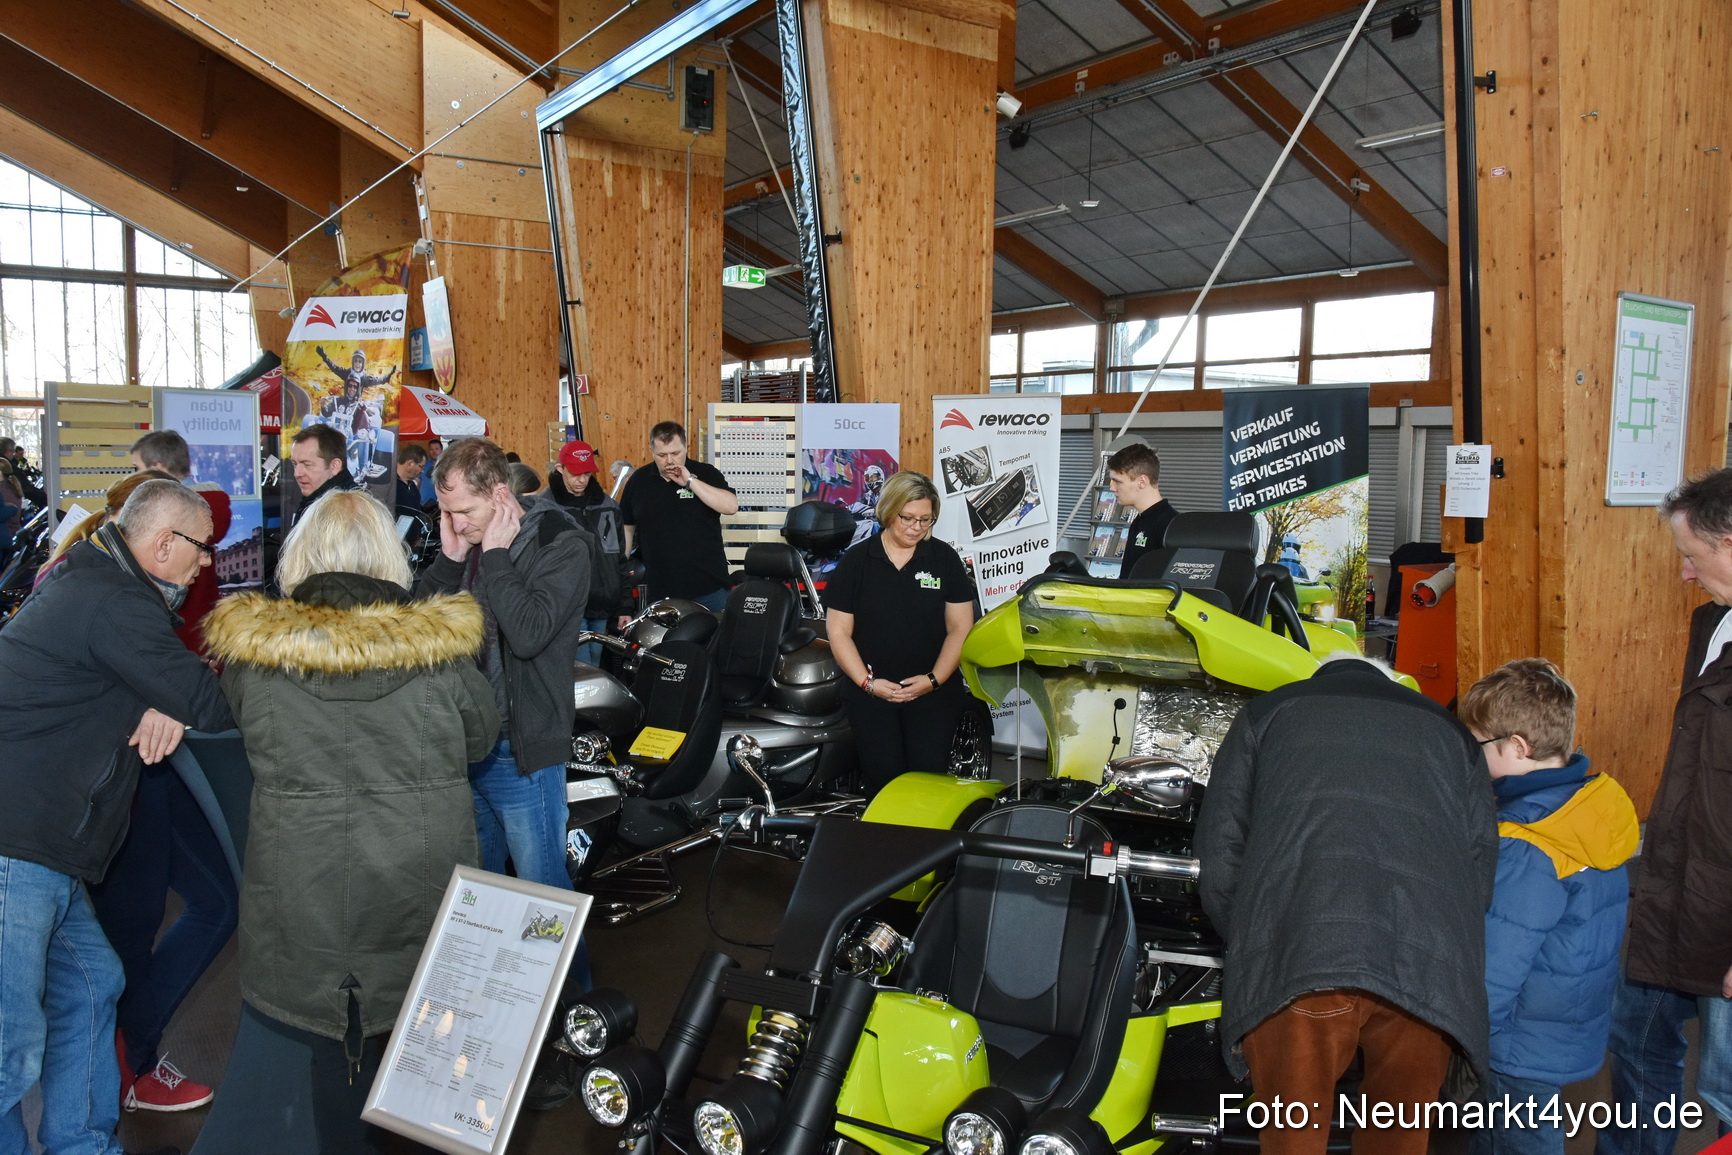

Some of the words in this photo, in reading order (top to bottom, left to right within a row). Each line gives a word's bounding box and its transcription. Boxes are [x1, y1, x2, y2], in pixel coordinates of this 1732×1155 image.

[340, 308, 404, 324] rewaco
[430, 408, 471, 416] YAMAHA
[978, 413, 1050, 426] rewaco
[834, 418, 866, 430] 50cc
[1230, 406, 1294, 442] VERKAUF
[938, 446, 951, 454] ABS
[1230, 421, 1321, 466] VERMIETUNG
[998, 452, 1031, 467] Tempomat
[1230, 436, 1346, 490] SERVICESTATION
[1228, 492, 1256, 512] FÜR
[1256, 475, 1308, 503] TRIKES
[979, 538, 1049, 564] Innovative
[982, 560, 1024, 580] triking
[985, 584, 1008, 596] Mehr
[992, 710, 1014, 719] System
[1036, 876, 1061, 886] ST
[454, 1112, 466, 1122] VK:
[467, 1116, 494, 1133] 33500,-
